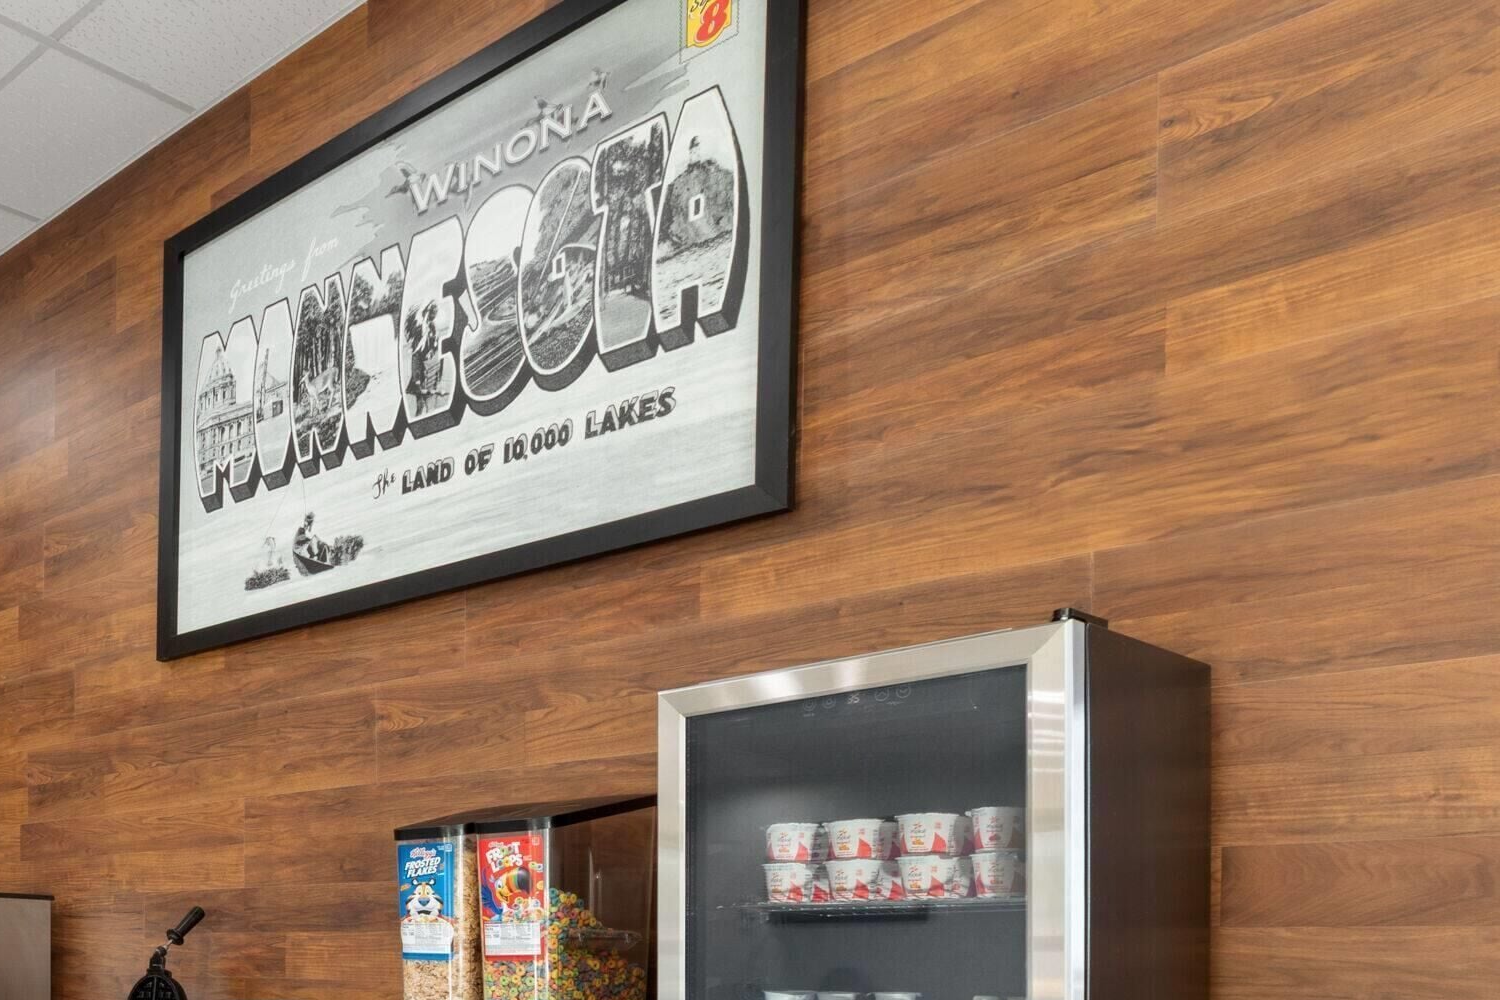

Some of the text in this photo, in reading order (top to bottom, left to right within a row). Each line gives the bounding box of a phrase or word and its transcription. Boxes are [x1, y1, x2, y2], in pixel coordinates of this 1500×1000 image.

[409, 90, 612, 213] WINONA
[194, 84, 750, 513] MINNESOTA
[228, 236, 340, 313] Greetings from
[372, 386, 677, 499] The LAND OF 10,000 LAKES
[405, 857, 441, 872] FROSTED
[407, 864, 438, 879] FLAKES
[490, 854, 523, 873] LOOPS
